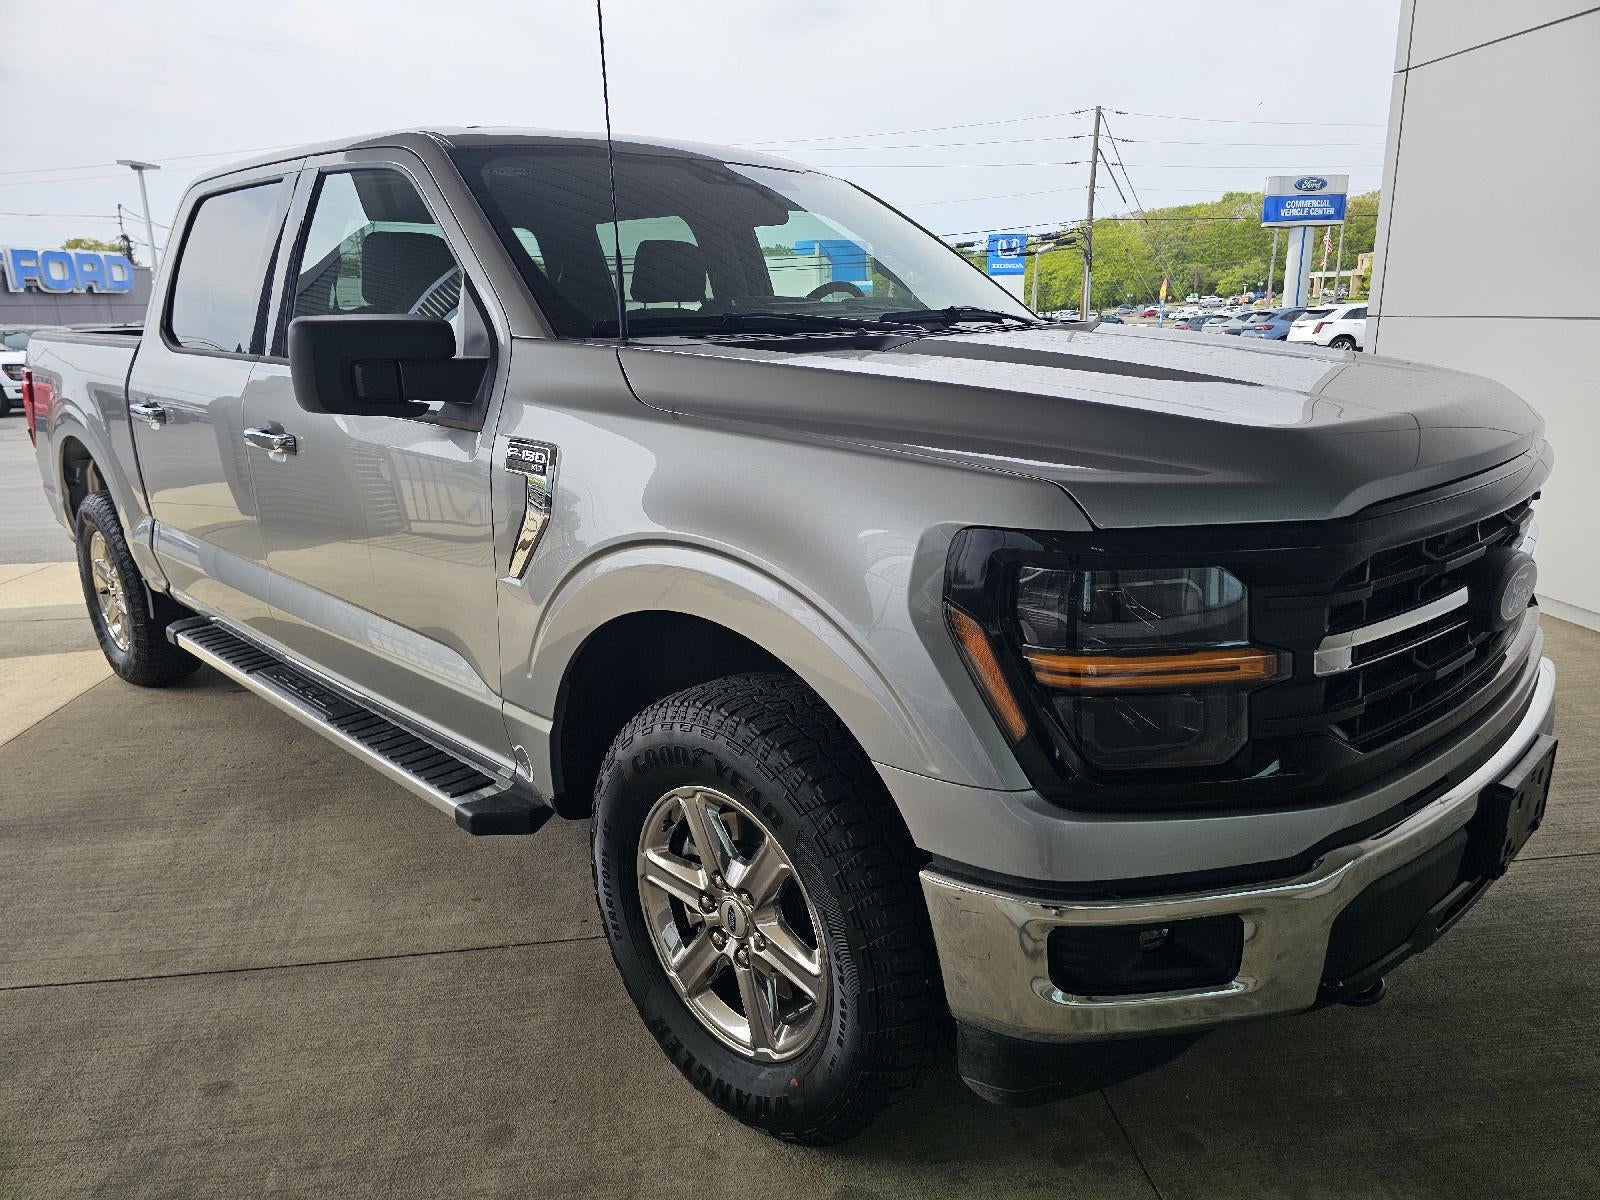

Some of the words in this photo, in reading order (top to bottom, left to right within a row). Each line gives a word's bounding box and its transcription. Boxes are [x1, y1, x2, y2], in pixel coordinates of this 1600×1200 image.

[1302, 178, 1323, 190] Ford
[1280, 208, 1309, 217] VEHICLE
[1310, 207, 1335, 216] CENTER
[1286, 199, 1331, 208] COMMERCIAL
[9, 248, 135, 292] FORD
[507, 447, 547, 464] F-150
[601, 847, 623, 942] TERRITORY
[652, 1014, 791, 1117] WRANGLER
